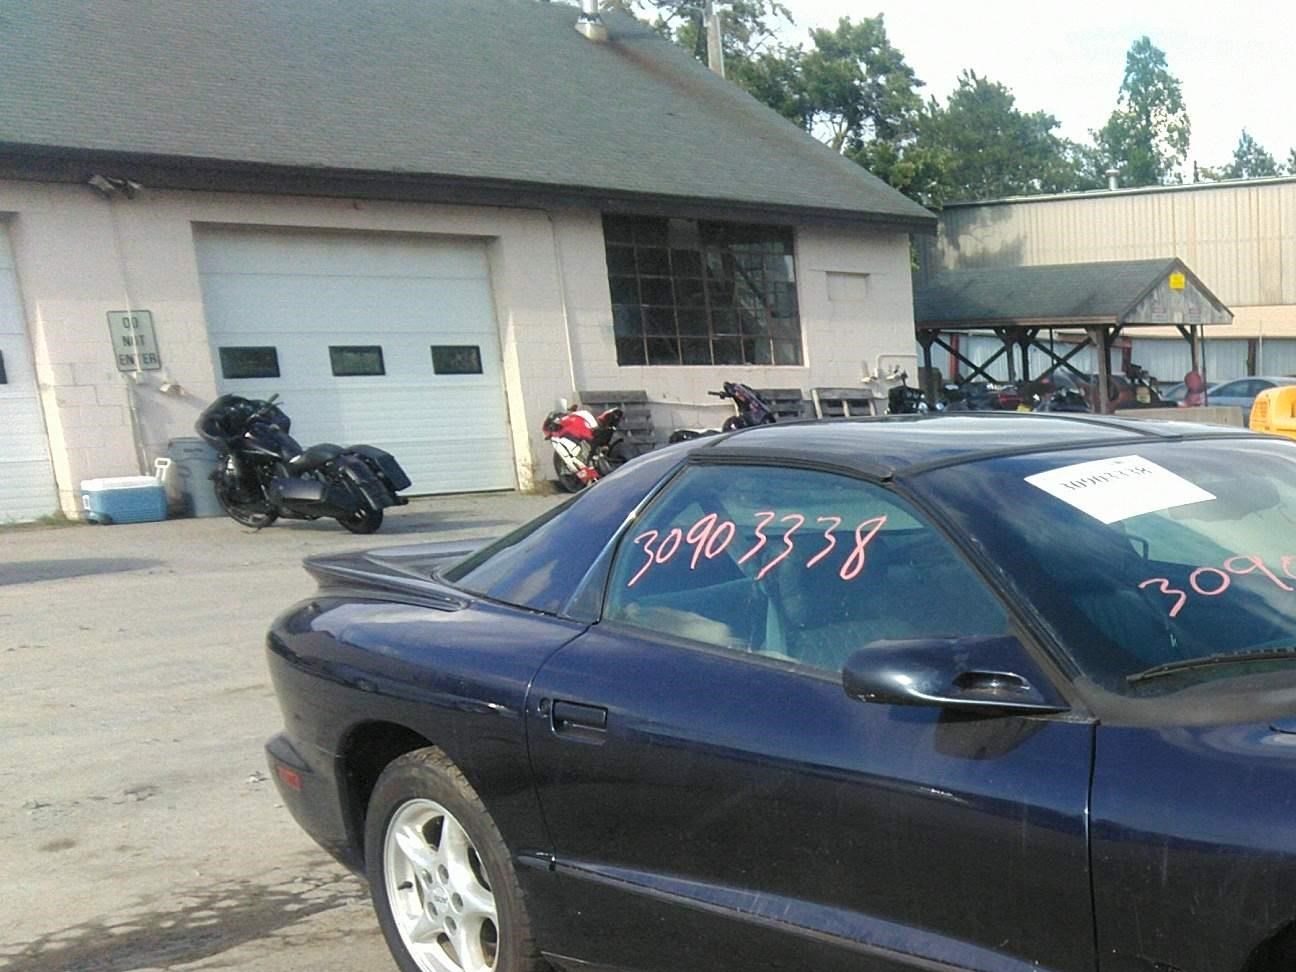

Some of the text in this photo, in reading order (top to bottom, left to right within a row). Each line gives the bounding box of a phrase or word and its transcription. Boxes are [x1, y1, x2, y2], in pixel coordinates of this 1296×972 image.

[122, 316, 139, 329] DO
[119, 352, 158, 366] ENER
[627, 511, 888, 587] 30903338
